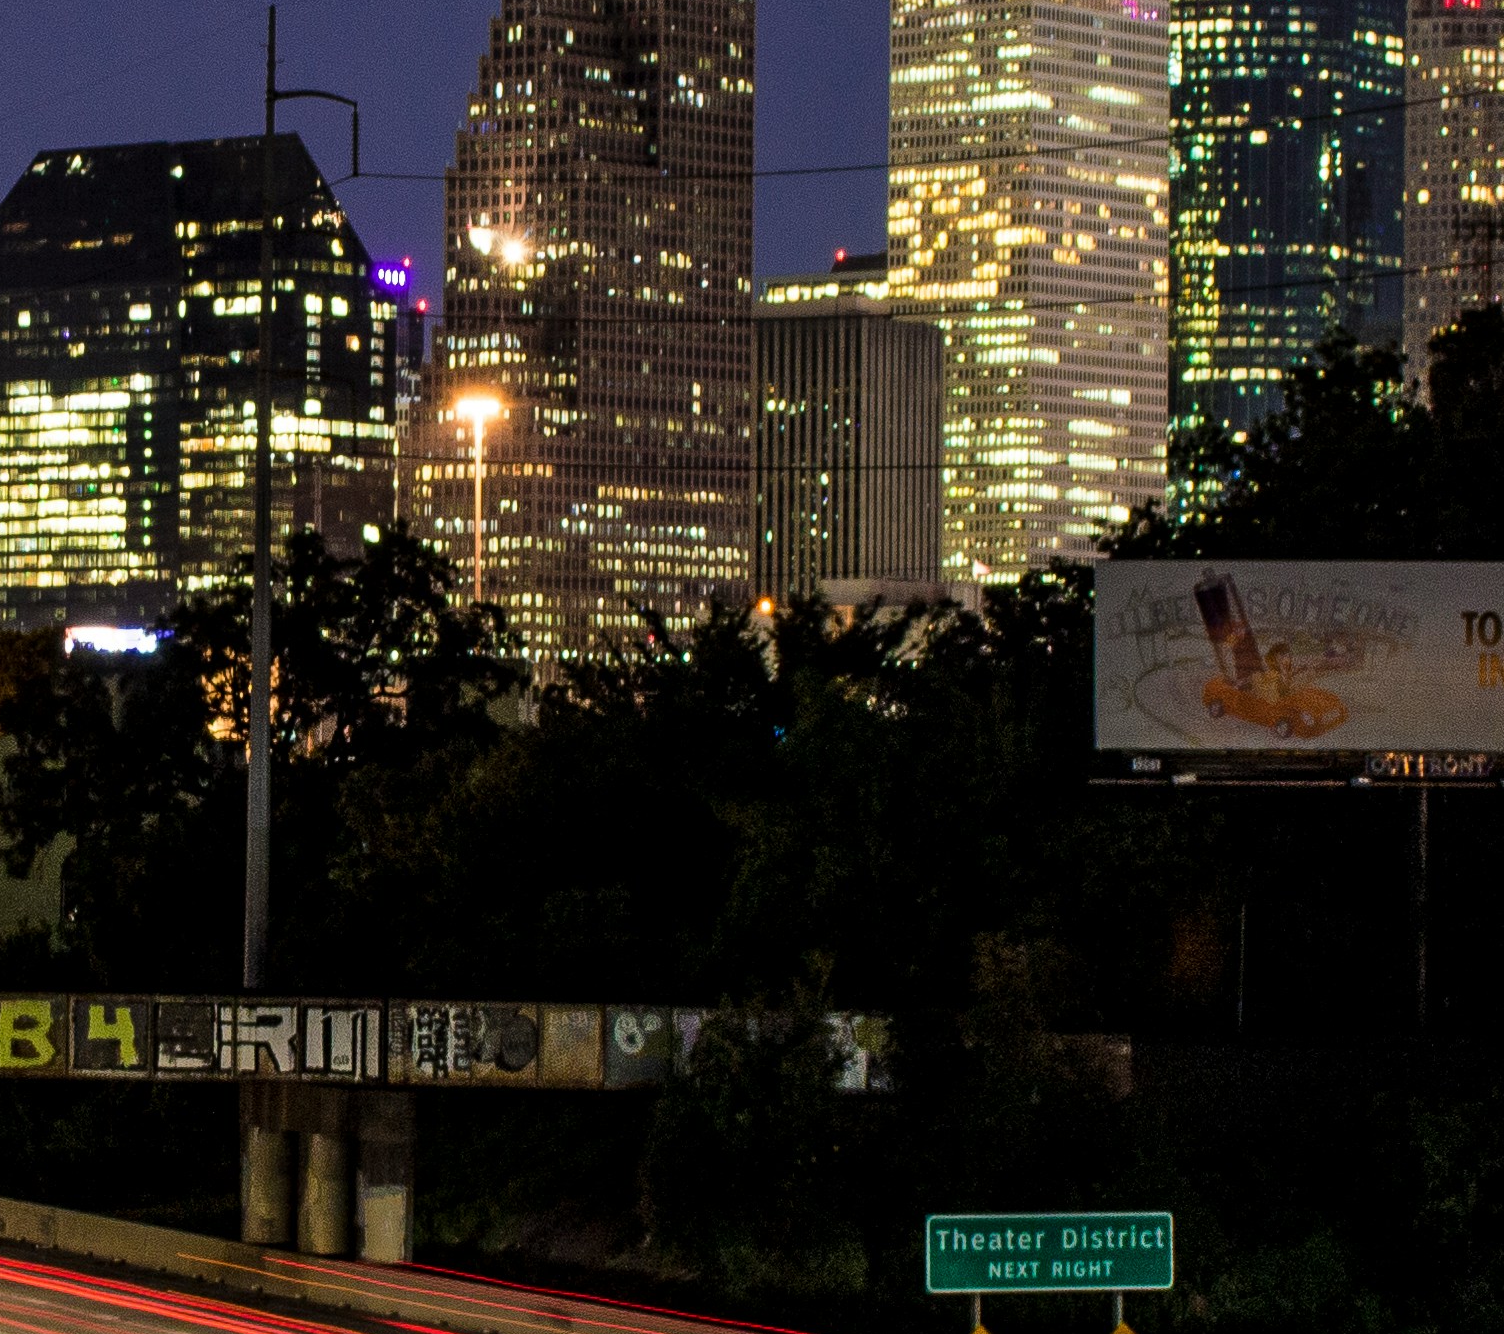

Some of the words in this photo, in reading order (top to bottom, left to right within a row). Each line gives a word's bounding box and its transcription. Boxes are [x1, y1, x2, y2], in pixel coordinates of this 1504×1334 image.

[1460, 611, 1504, 647] TO
[935, 1228, 1045, 1251] Theater
[1062, 1225, 1166, 1250] District
[988, 1260, 1040, 1279] NEXT
[1052, 1259, 1114, 1279] RIGHT
